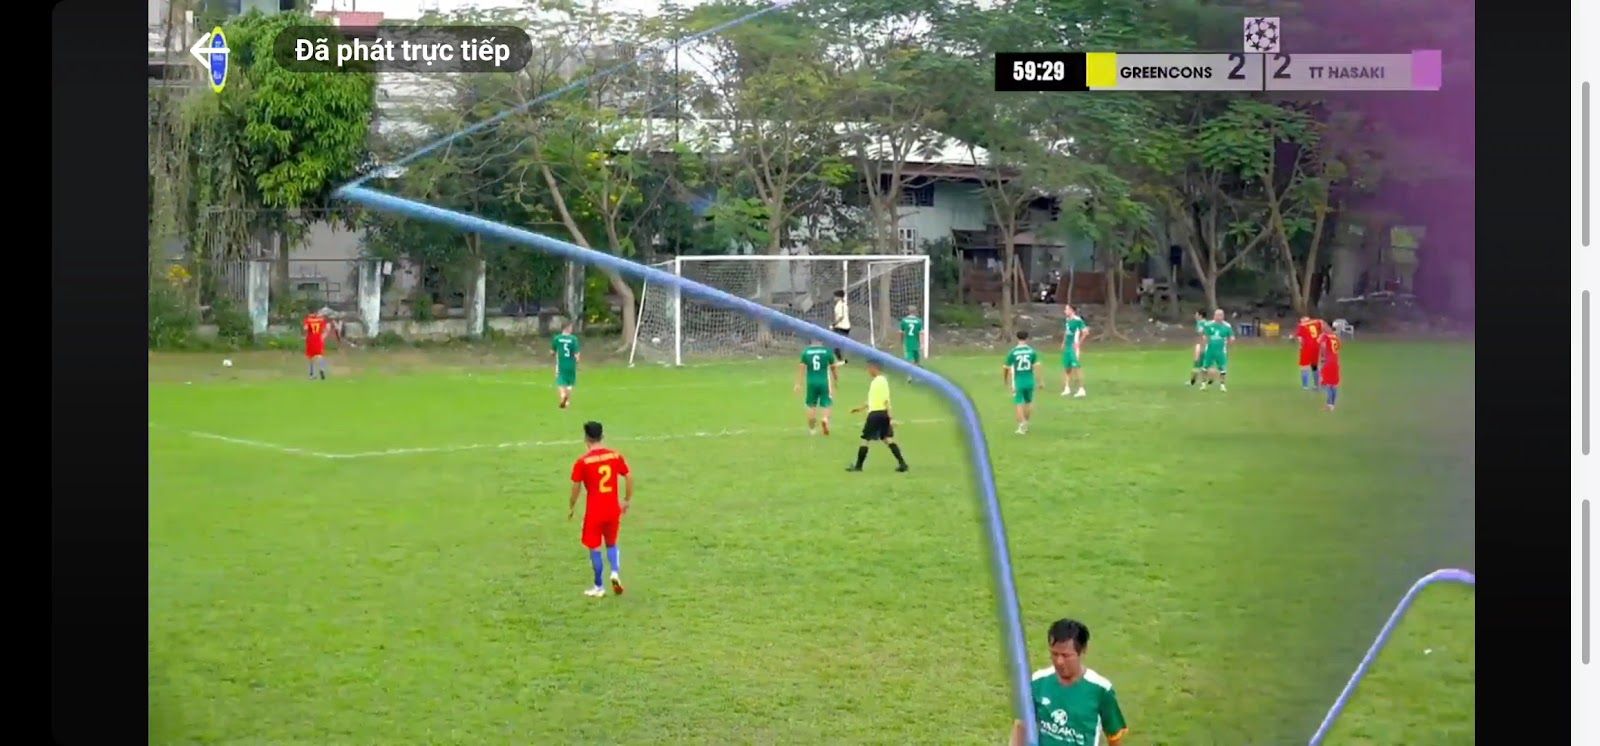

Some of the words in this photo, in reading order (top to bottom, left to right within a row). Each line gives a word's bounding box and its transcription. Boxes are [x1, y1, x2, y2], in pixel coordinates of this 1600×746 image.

[563, 343, 571, 357] 5
[812, 354, 821, 371] 6
[1016, 354, 1032, 371] 25
[598, 464, 613, 493] 2
